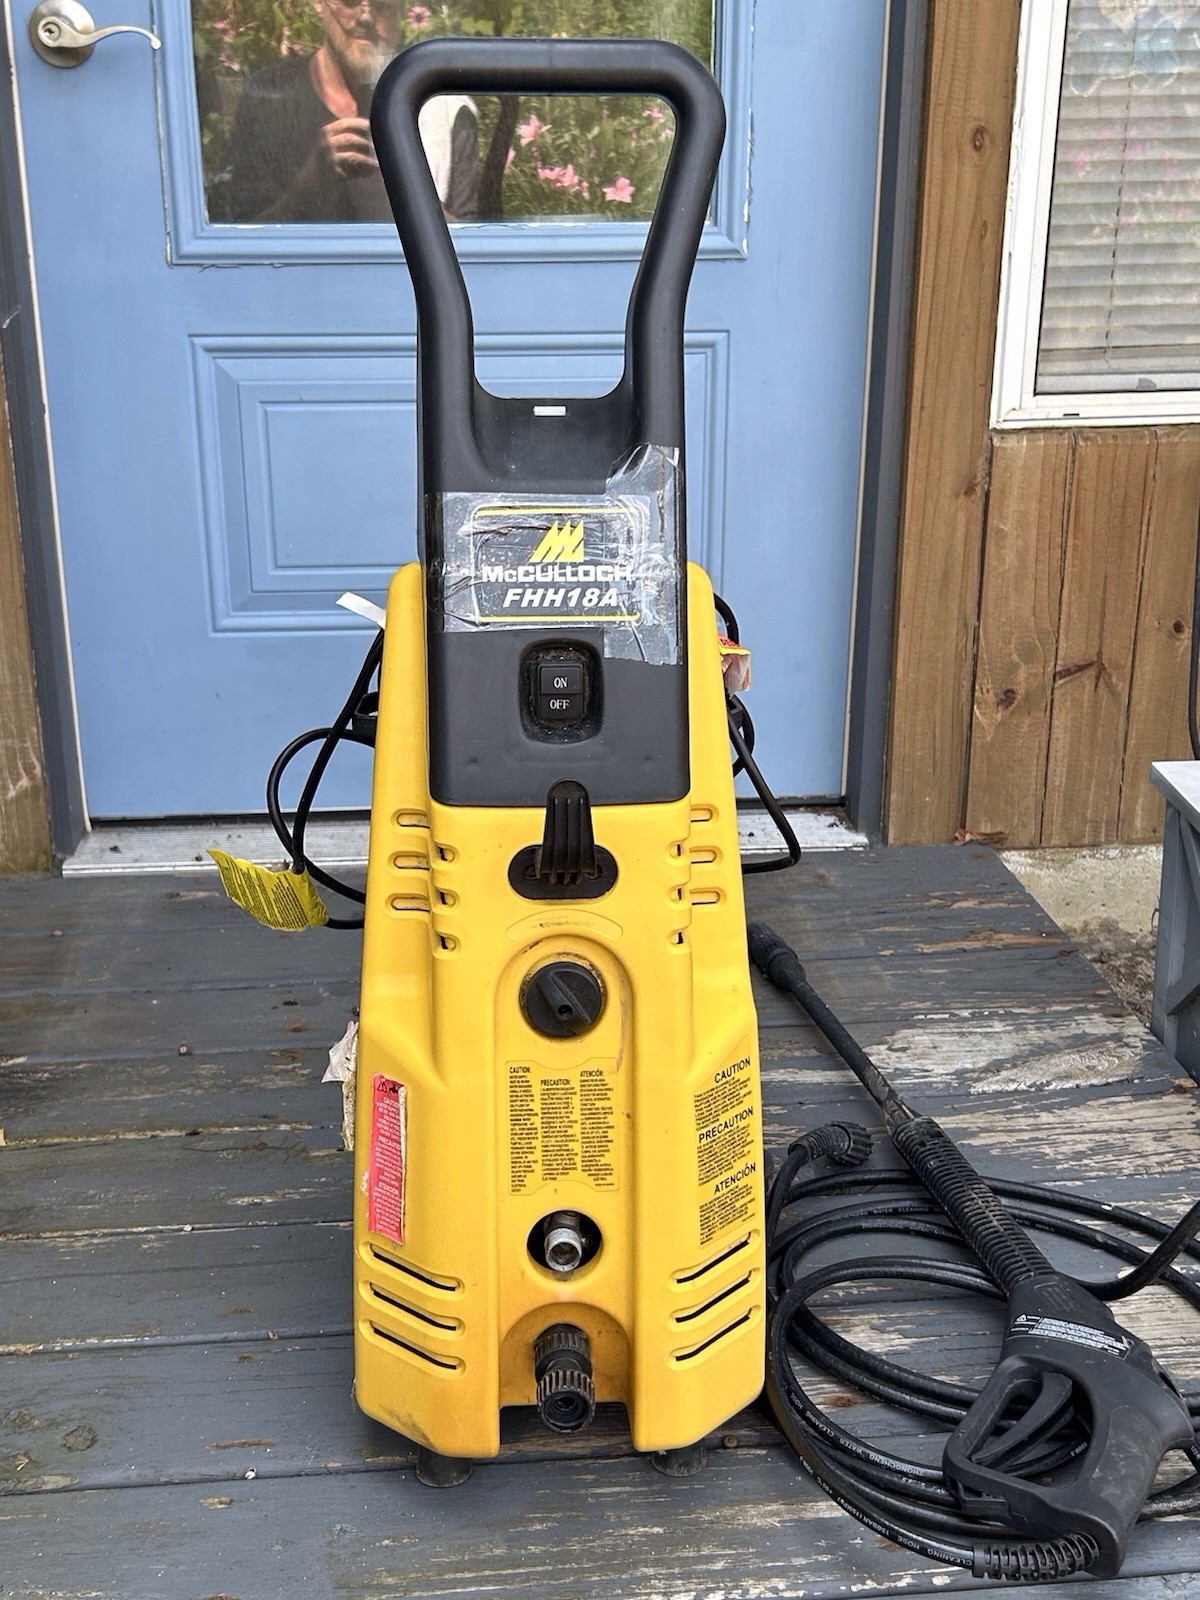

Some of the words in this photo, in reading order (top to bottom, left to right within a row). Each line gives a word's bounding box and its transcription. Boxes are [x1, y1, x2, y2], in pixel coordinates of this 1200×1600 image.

[482, 565, 631, 583] McCULLOCH
[503, 588, 620, 608] FHH18A
[553, 676, 568, 688] ON
[549, 699, 571, 710] OFF
[714, 1056, 751, 1083] CAUTION
[698, 1106, 754, 1143] PRECAUTION
[713, 1162, 756, 1195] ATENCIÓN
[805, 1410, 835, 1437] CLEANING
[839, 1438, 864, 1455] WATER
[868, 1453, 924, 1476] ZHONGCHENG
[897, 1536, 920, 1550] HOSE
[926, 1548, 973, 1566] CLEANING
